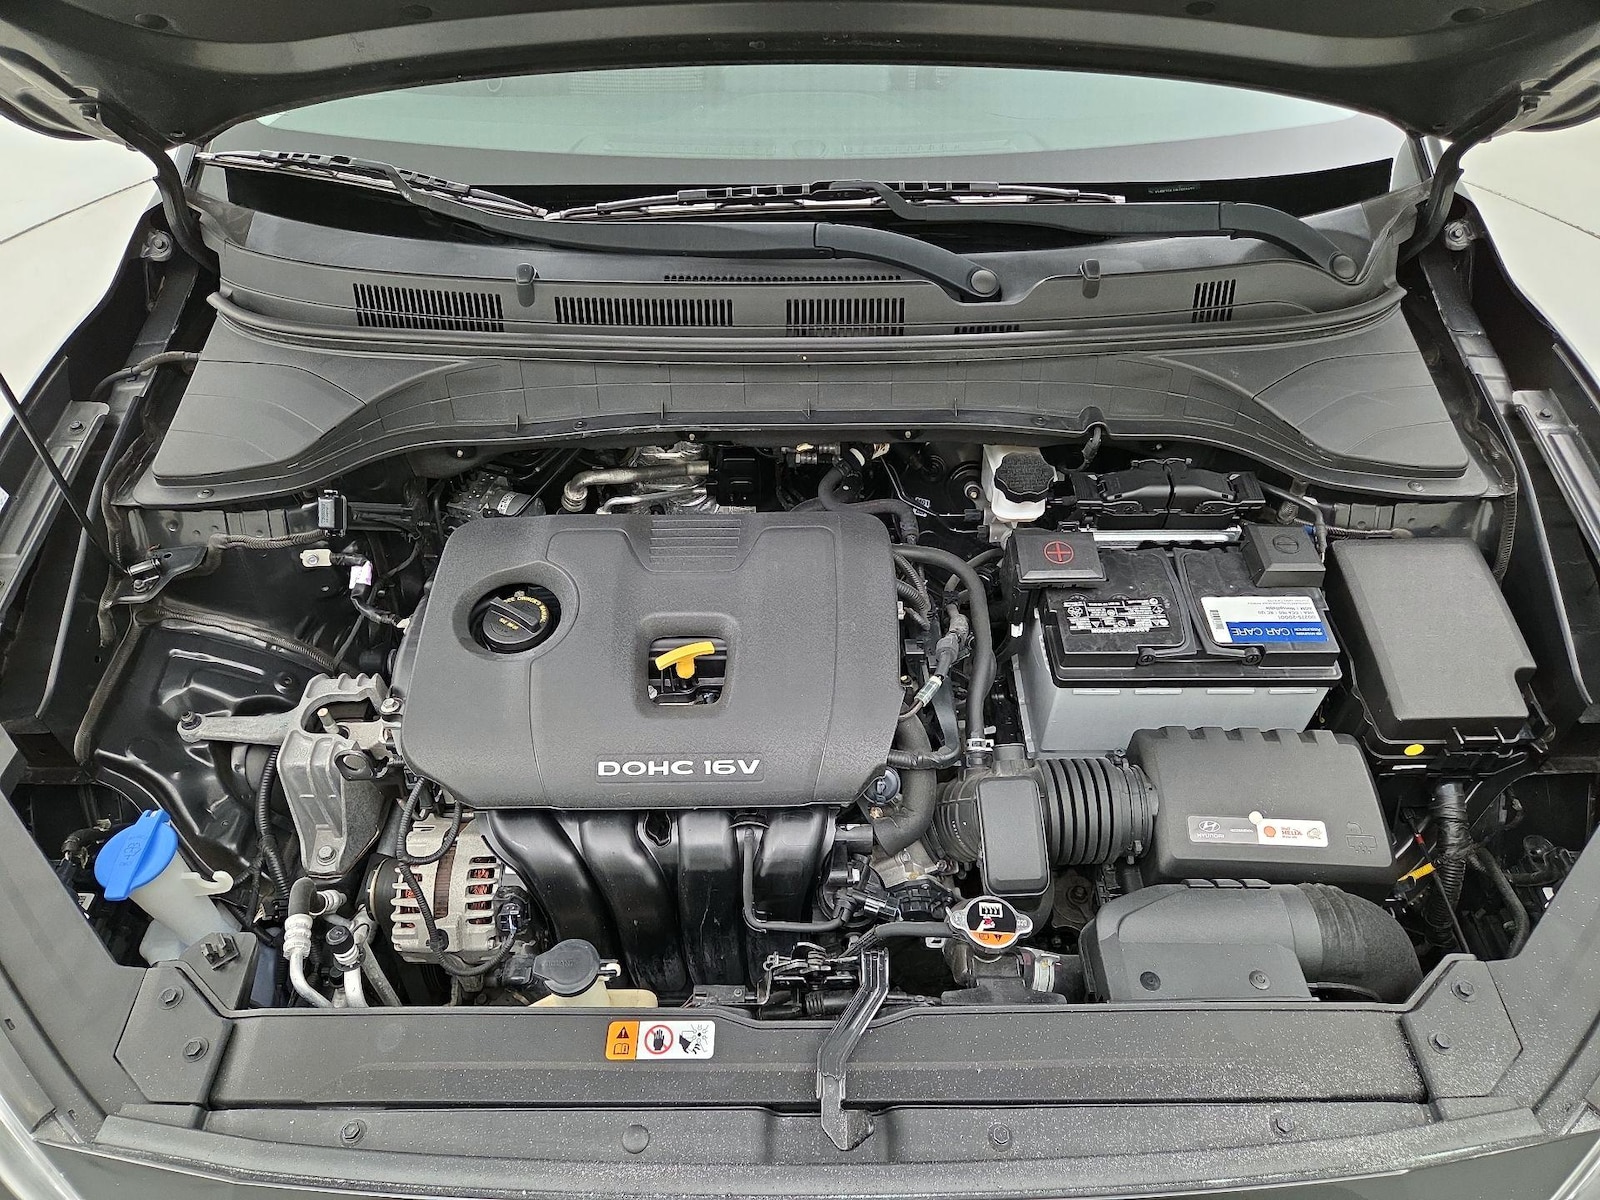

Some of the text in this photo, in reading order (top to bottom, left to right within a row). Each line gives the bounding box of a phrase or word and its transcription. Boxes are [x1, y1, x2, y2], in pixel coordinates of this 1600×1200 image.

[1231, 627, 1291, 636] CAR CARE
[597, 759, 761, 776] DOHC 16V
